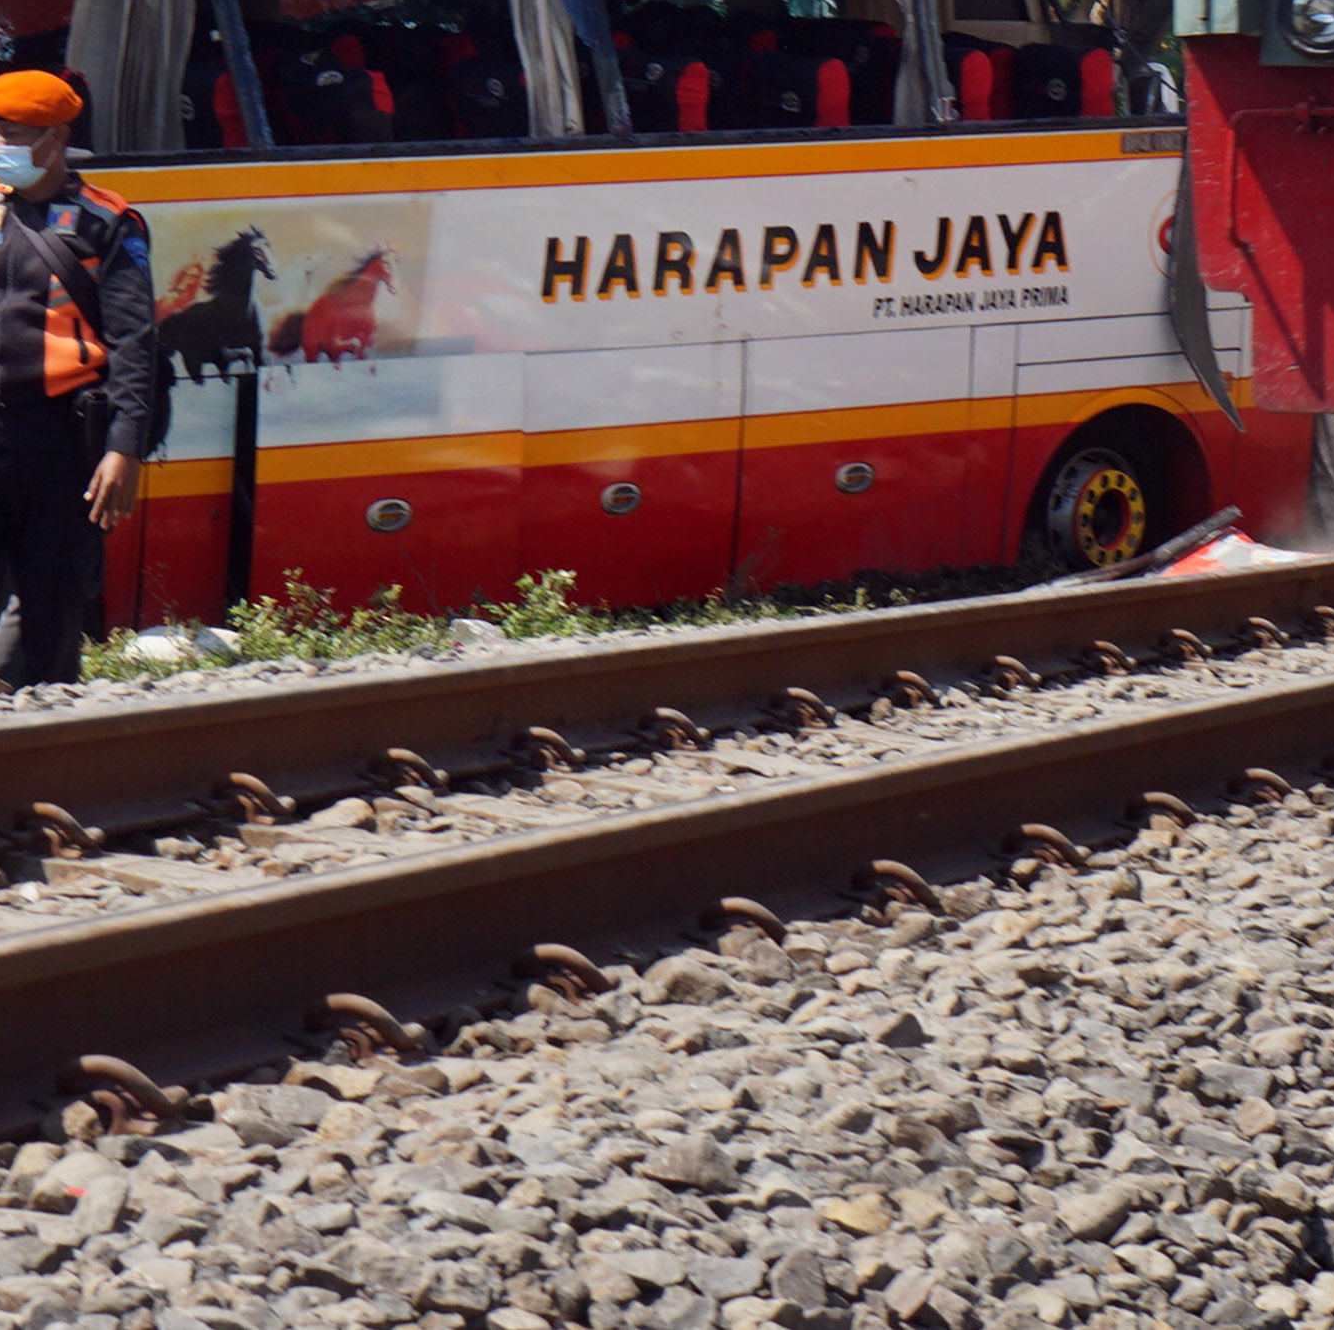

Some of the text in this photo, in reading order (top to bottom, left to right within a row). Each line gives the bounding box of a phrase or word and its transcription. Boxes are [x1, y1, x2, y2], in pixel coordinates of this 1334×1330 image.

[541, 210, 1070, 304] HARAPAN JAYA
[873, 284, 1070, 319] PT. HARAPAN JAYA PRIMA
